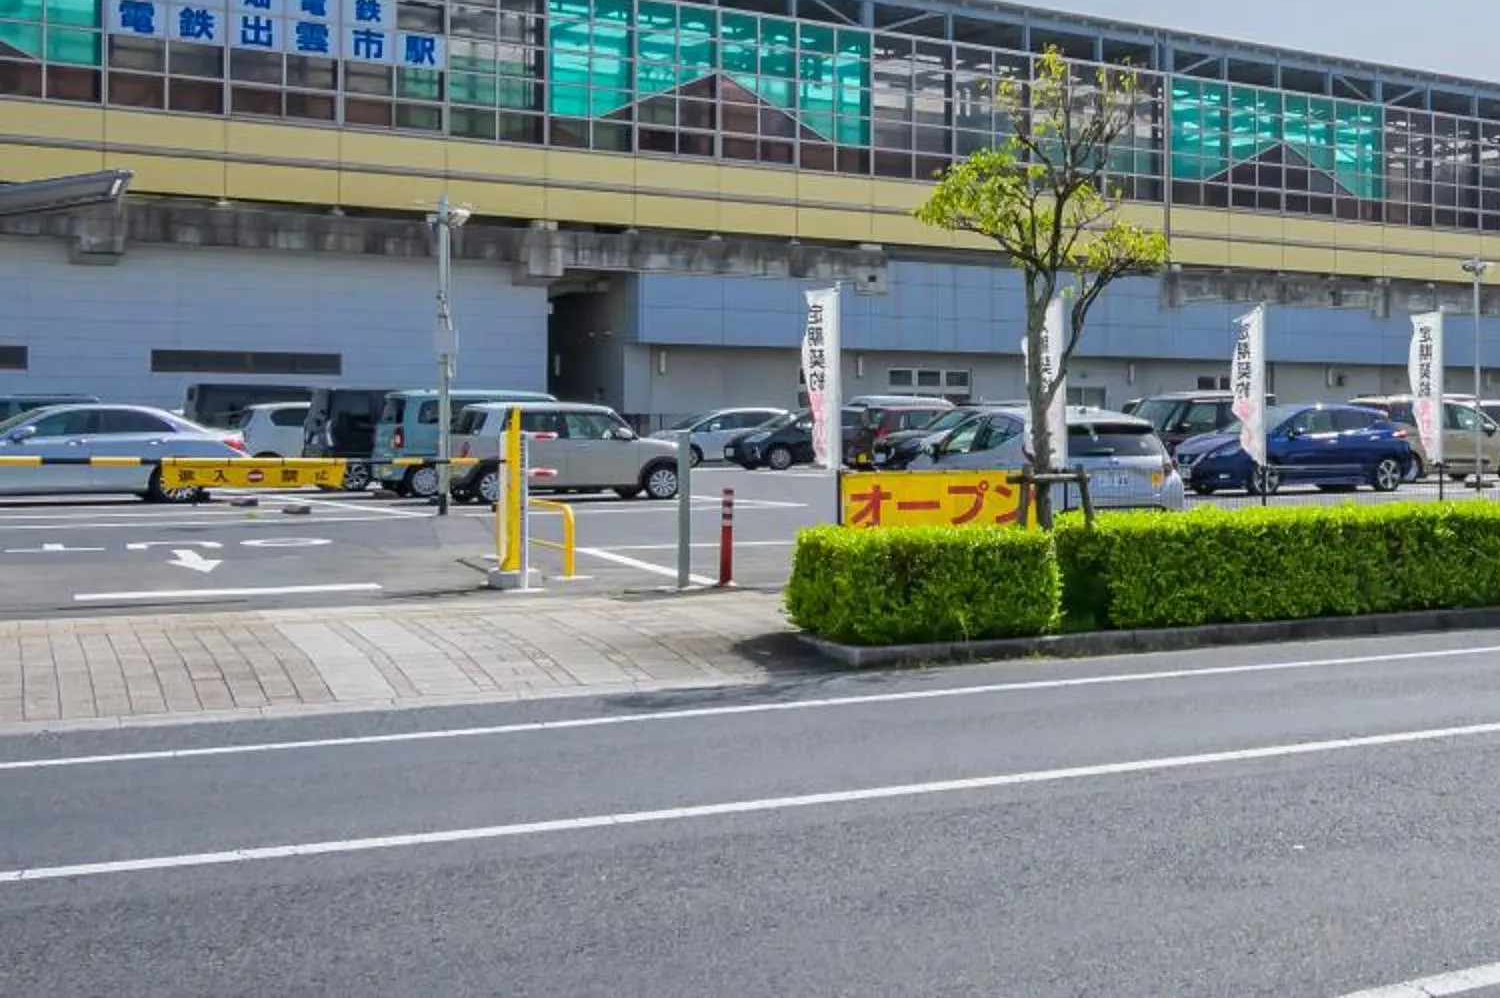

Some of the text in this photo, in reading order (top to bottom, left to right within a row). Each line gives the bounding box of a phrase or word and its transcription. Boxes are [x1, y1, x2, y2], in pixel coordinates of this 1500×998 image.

[119, 0, 436, 65] 電鉄出雲市駅
